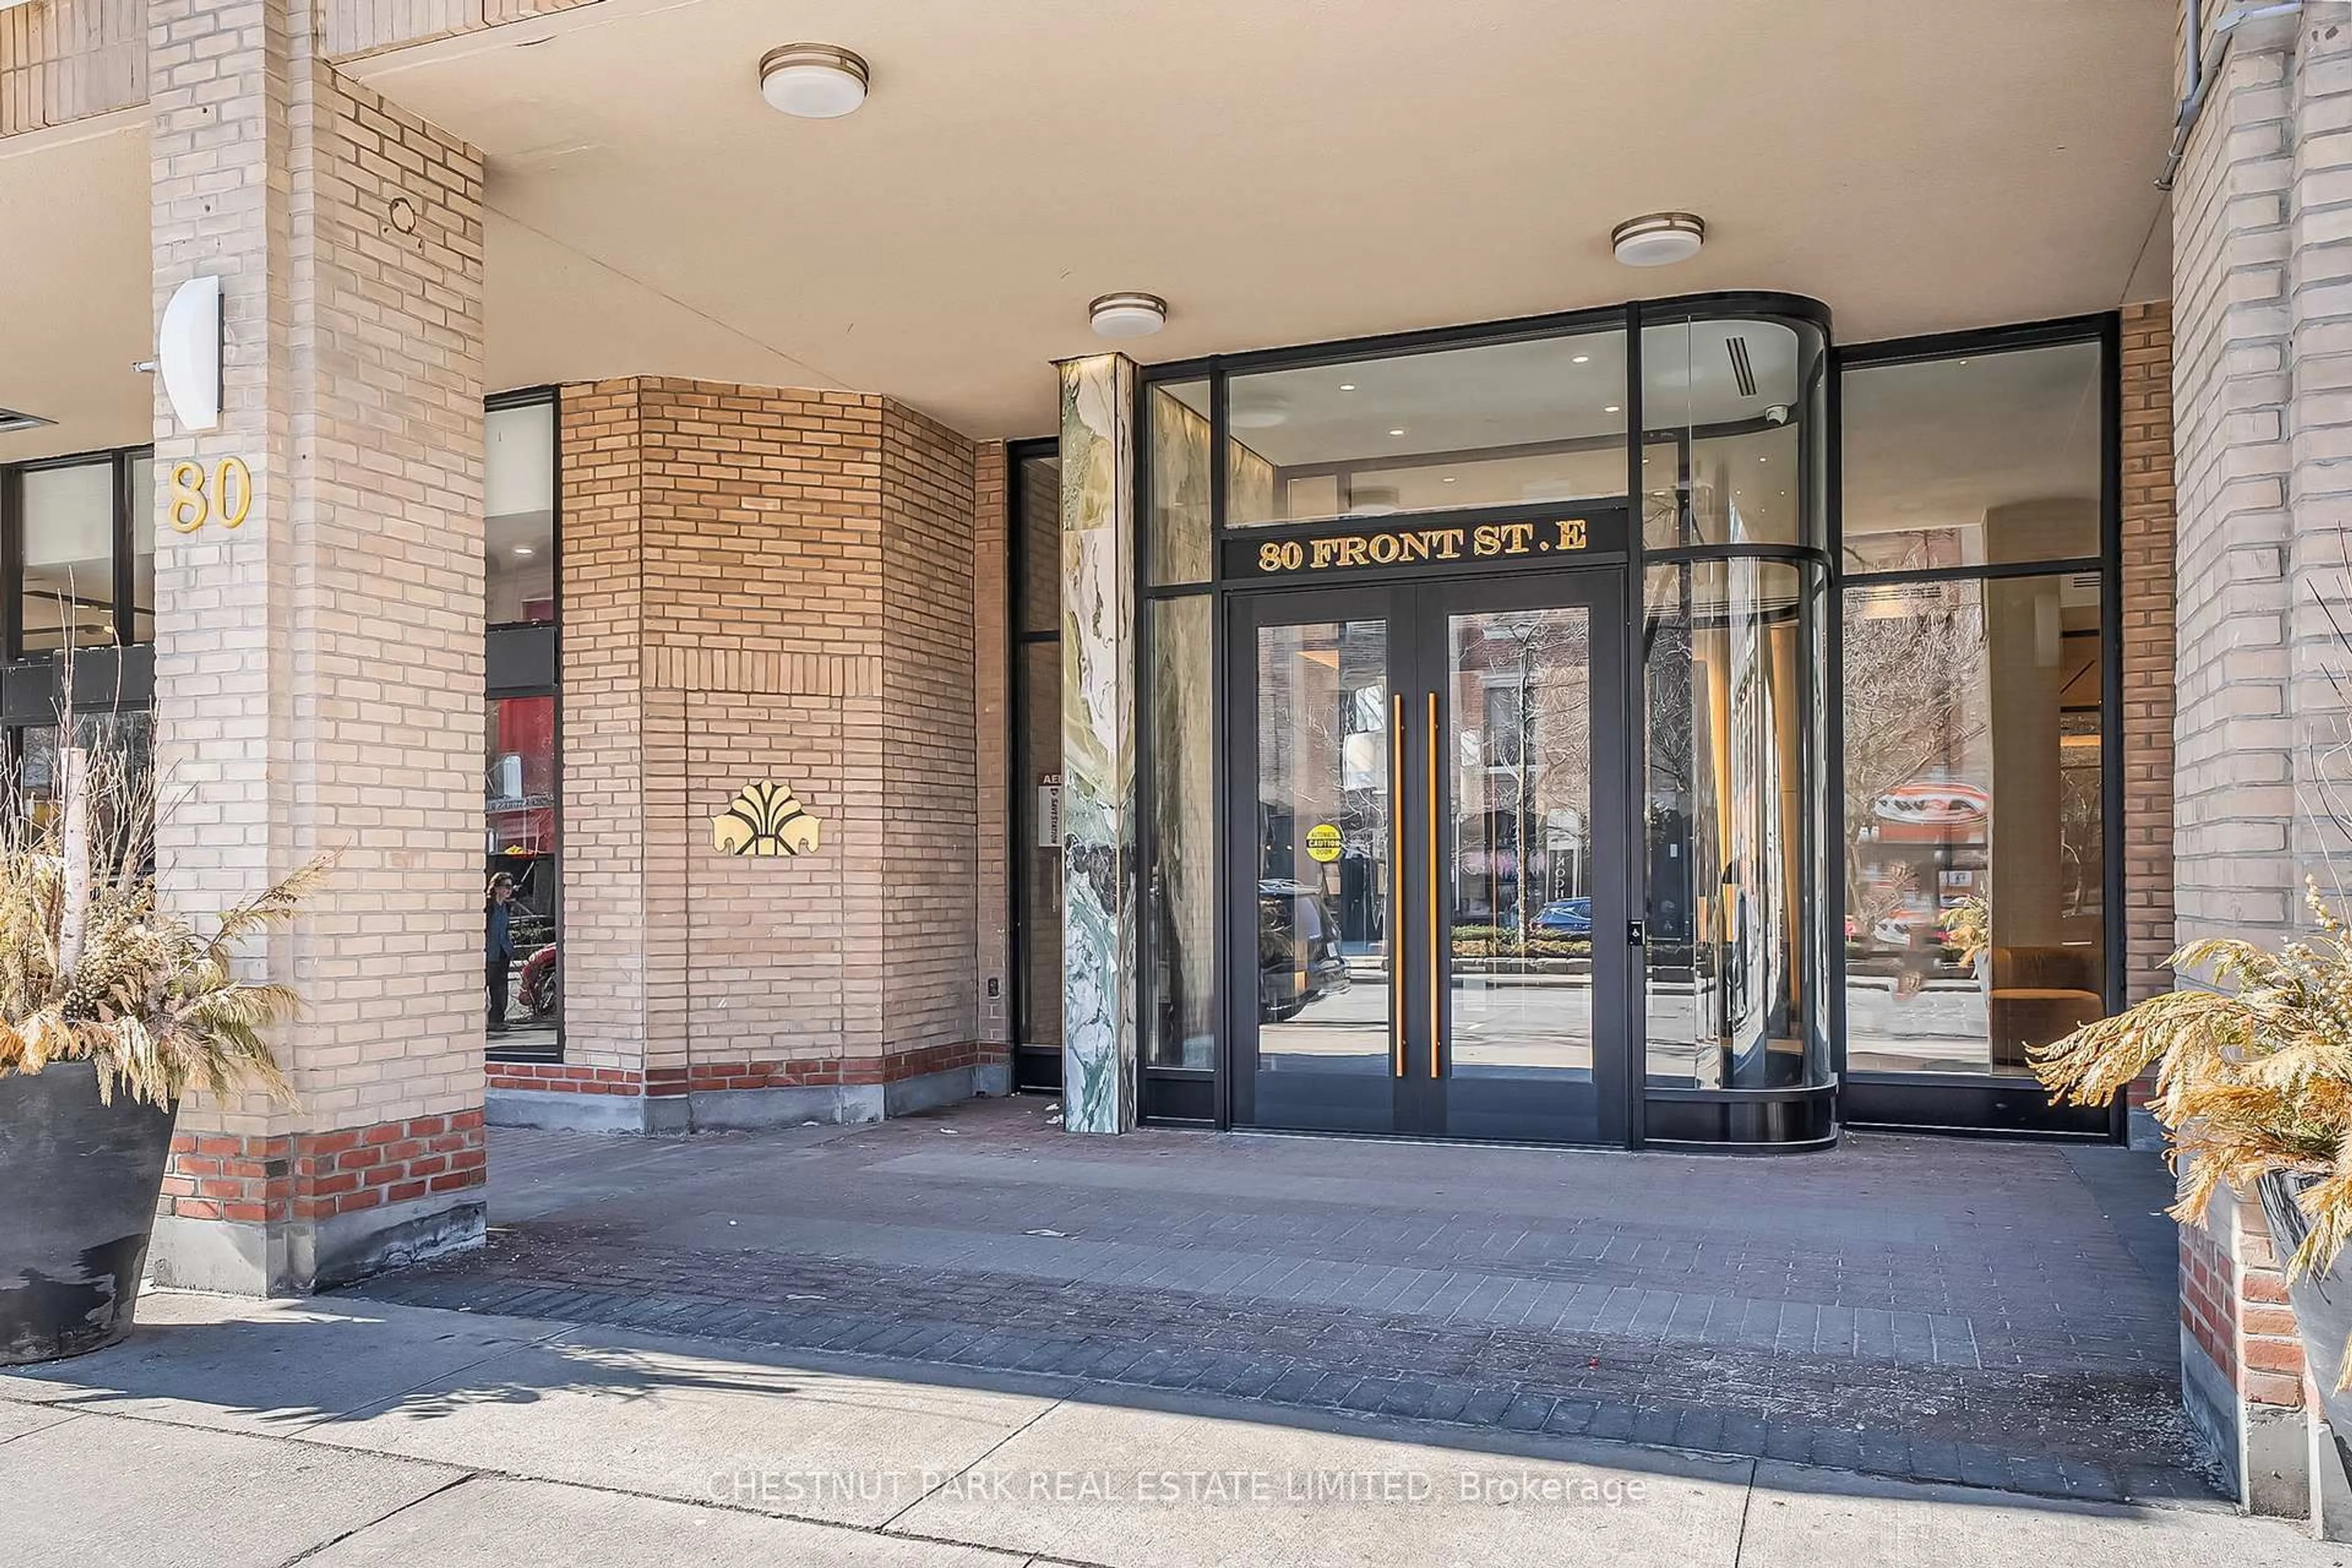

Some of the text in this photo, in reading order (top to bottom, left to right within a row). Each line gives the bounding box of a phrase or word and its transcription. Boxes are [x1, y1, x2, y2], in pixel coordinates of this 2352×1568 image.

[168, 456, 252, 534] 80
[1259, 541, 1303, 572] 80
[1310, 529, 1464, 568] FRONT
